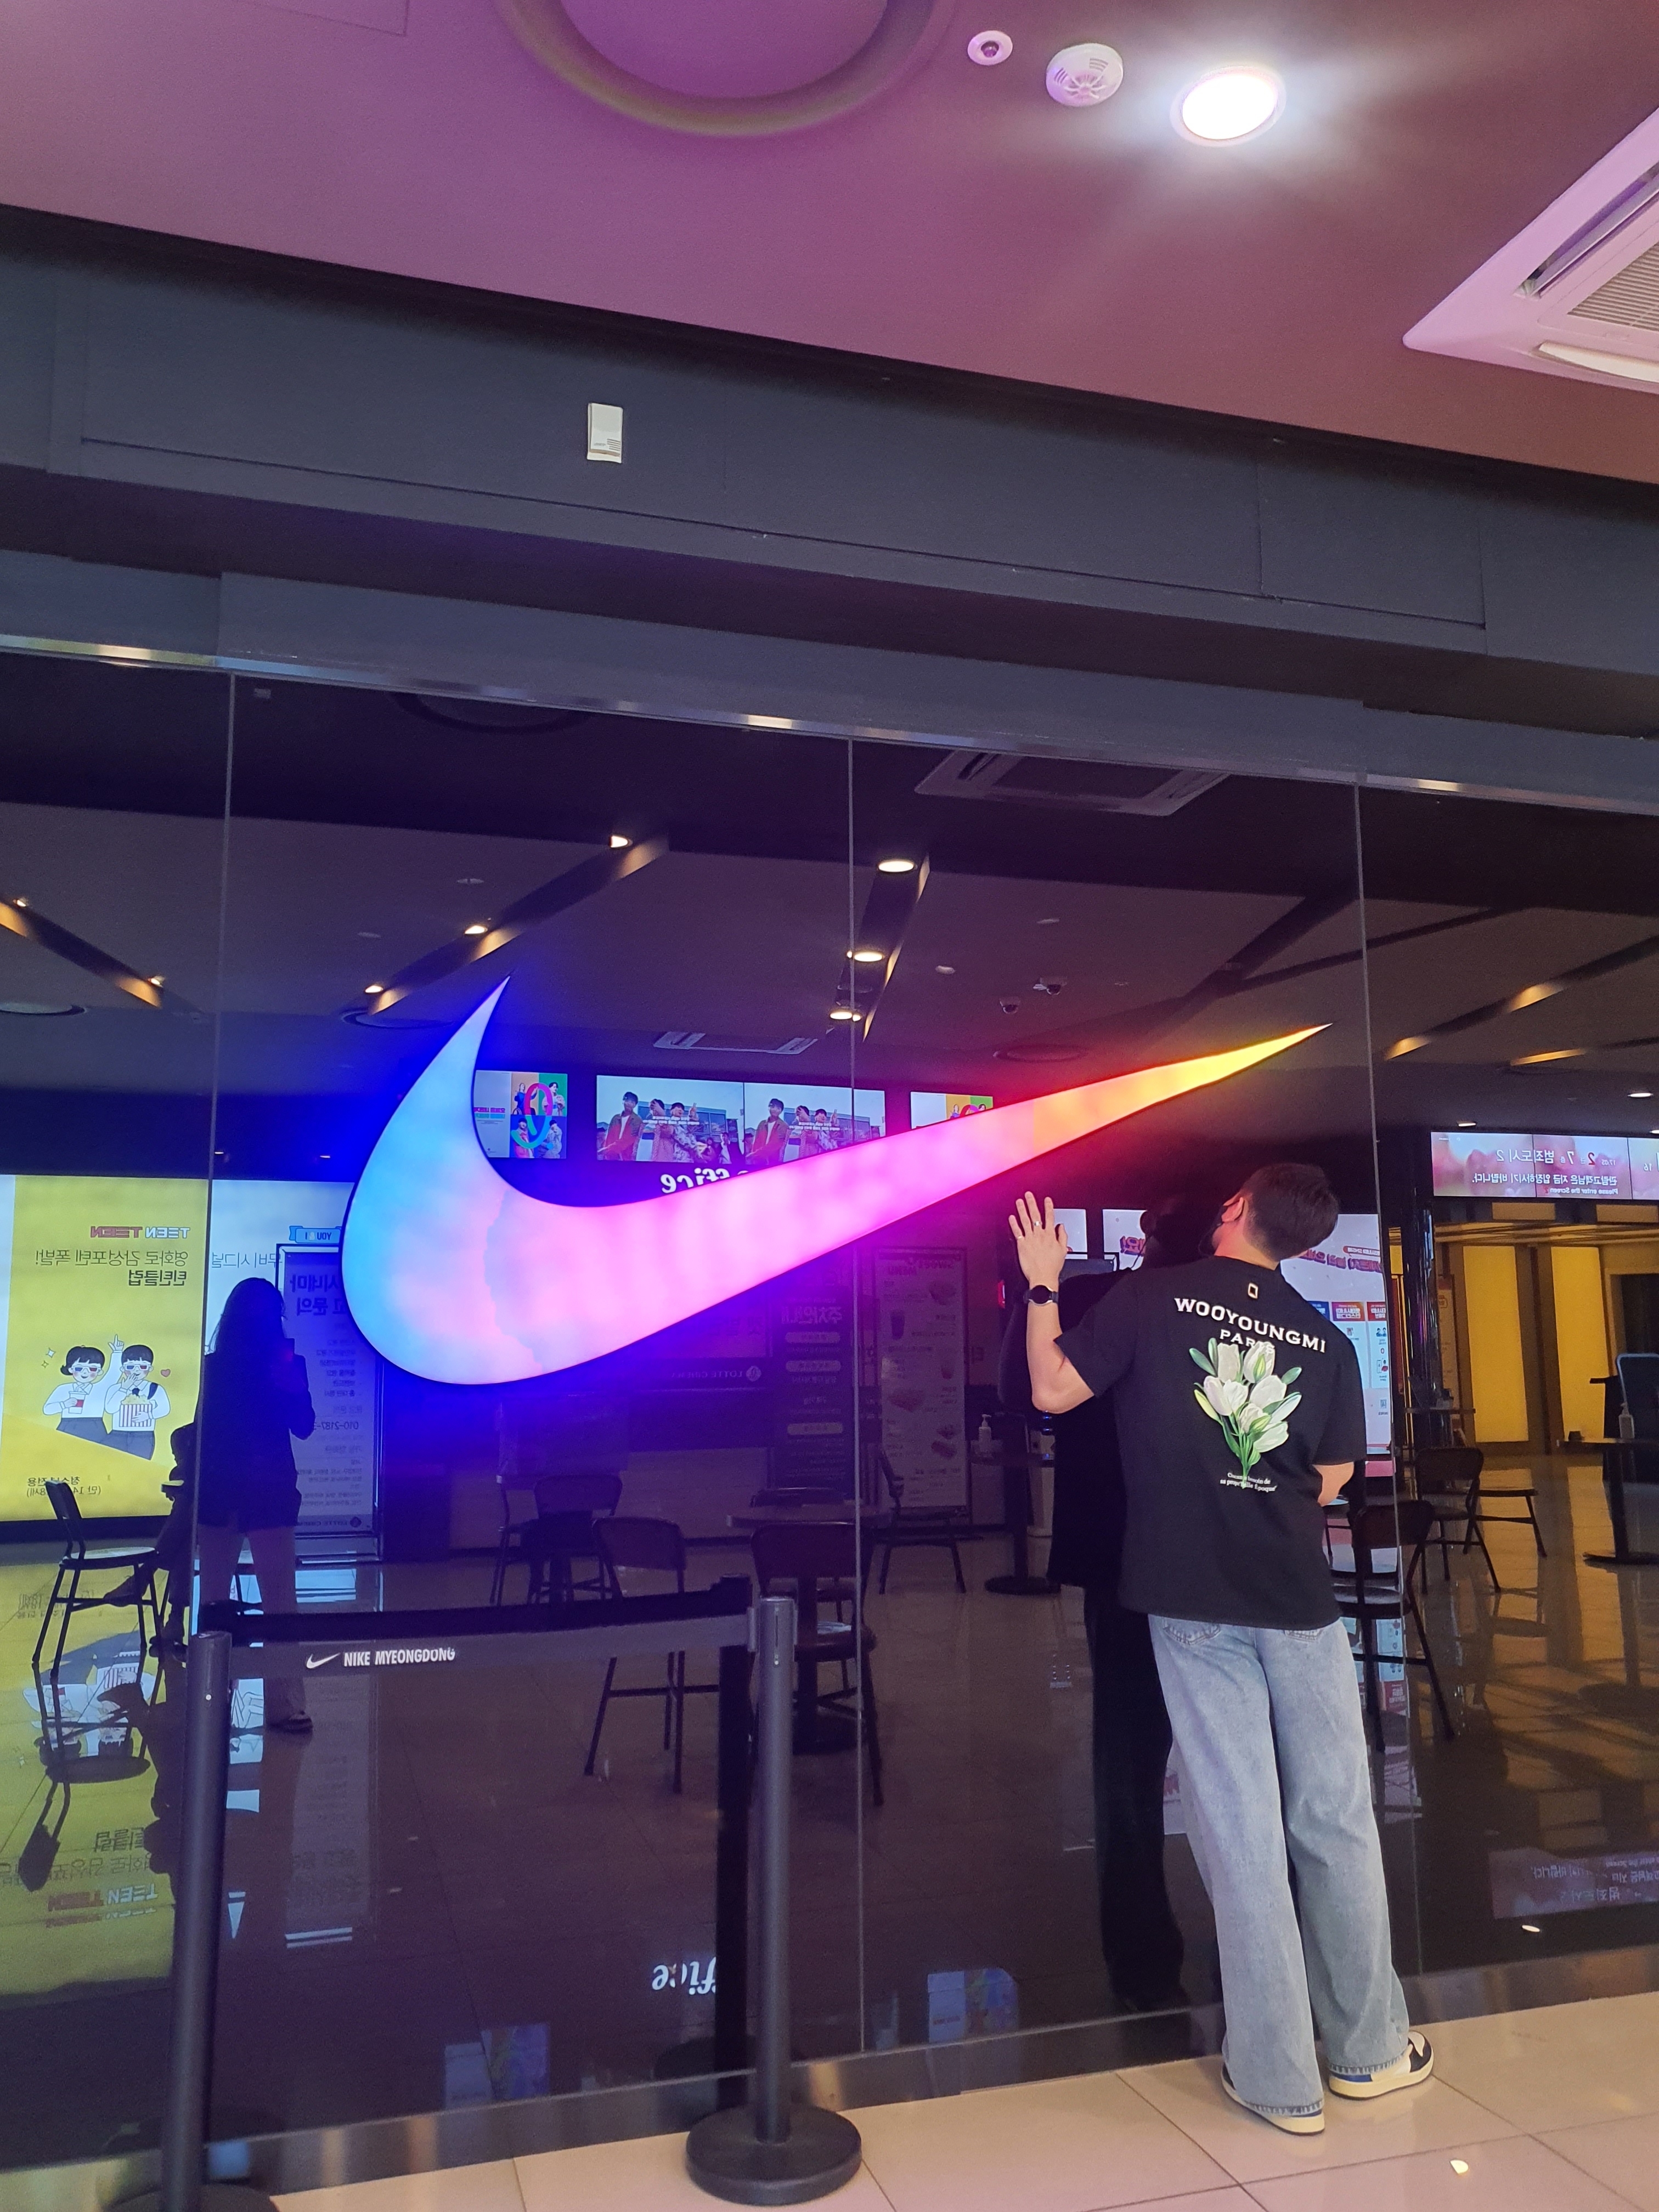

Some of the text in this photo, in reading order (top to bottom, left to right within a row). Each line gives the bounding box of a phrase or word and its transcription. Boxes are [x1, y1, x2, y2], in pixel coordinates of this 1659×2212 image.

[1174, 1297, 1326, 1353] WOOYOUNGMI
[343, 1646, 456, 1667] NIKE MYEONGDONG
